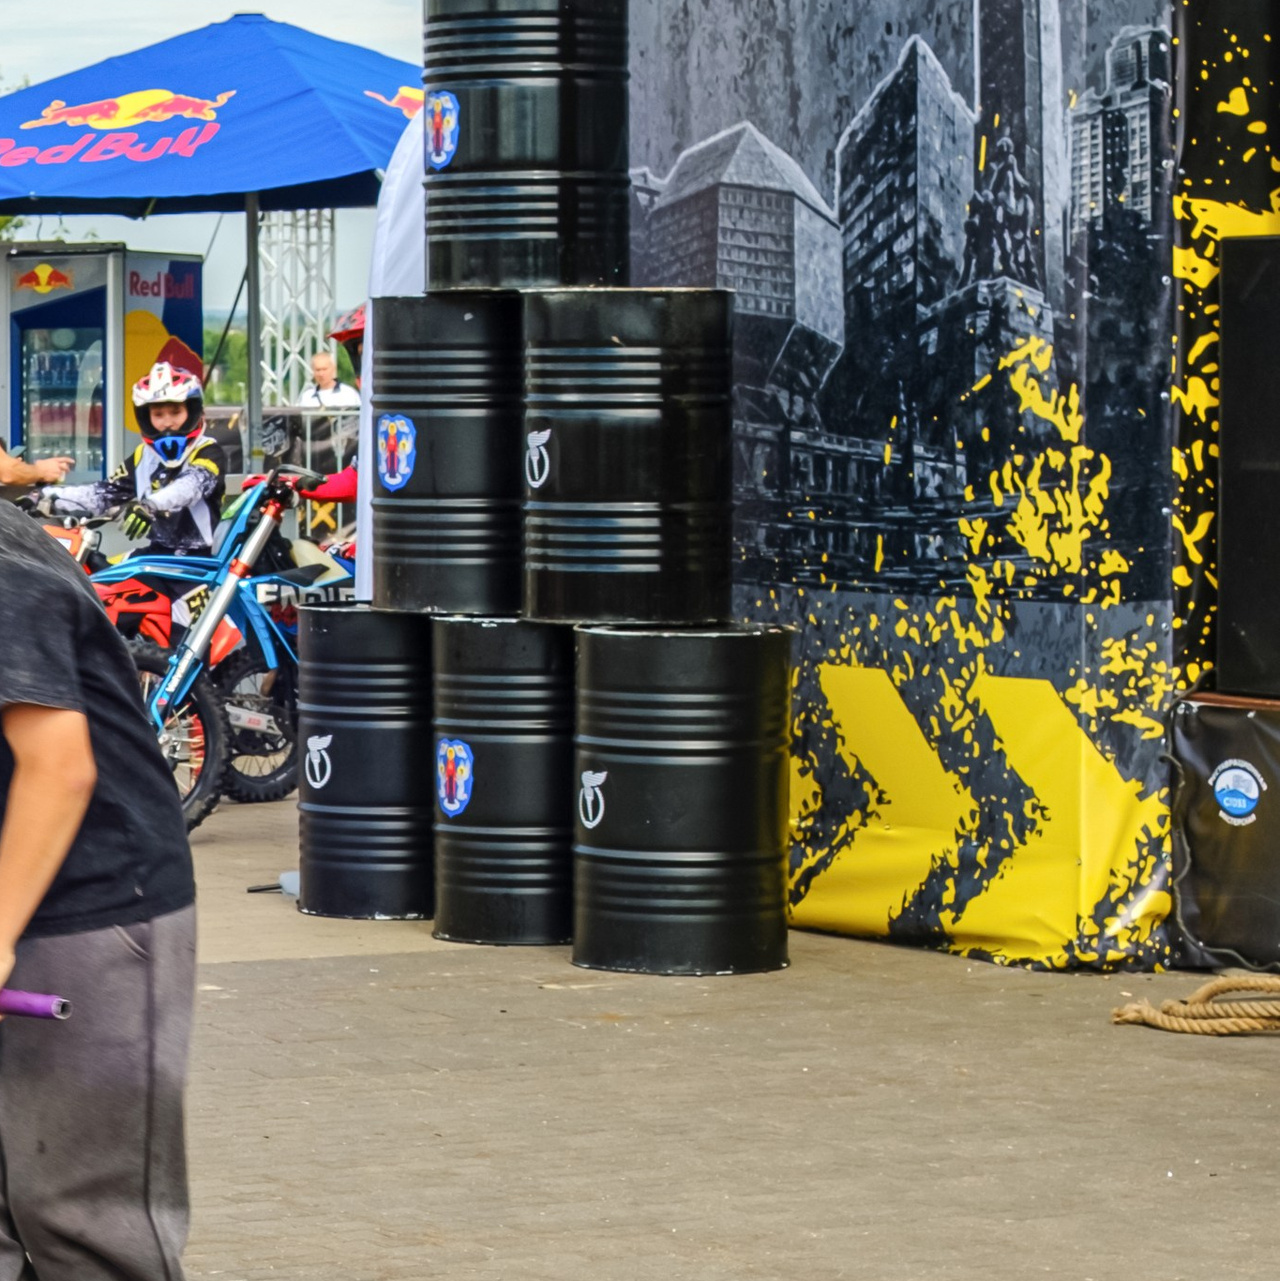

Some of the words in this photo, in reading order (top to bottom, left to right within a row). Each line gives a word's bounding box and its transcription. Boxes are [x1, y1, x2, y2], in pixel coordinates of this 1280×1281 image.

[78, 122, 221, 162] Bull
[129, 271, 161, 297] Red
[163, 273, 195, 299] Bull
